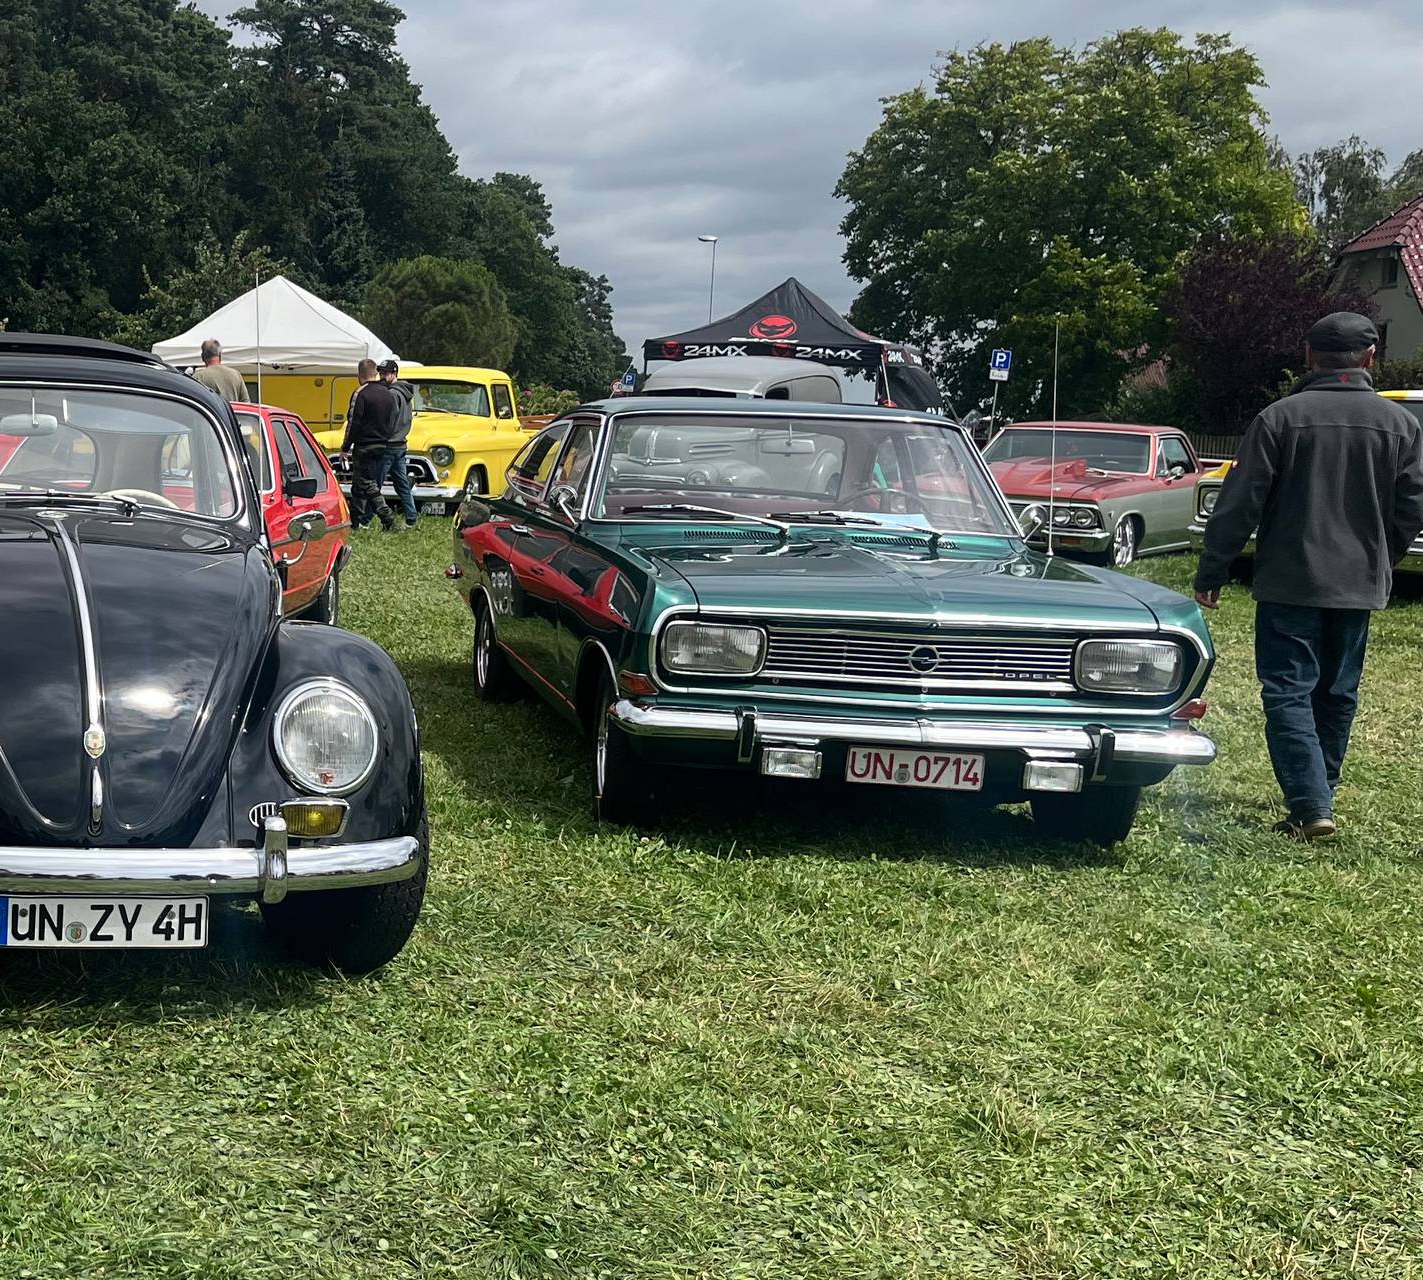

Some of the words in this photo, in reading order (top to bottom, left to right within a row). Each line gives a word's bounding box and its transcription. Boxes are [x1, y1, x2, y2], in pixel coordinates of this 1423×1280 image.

[683, 345, 748, 357] 24MX
[795, 346, 863, 361] 24MX
[995, 352, 1007, 367] P
[1005, 672, 1056, 680] OPEL
[89, 904, 143, 942] ZY
[152, 903, 203, 942] 4H
